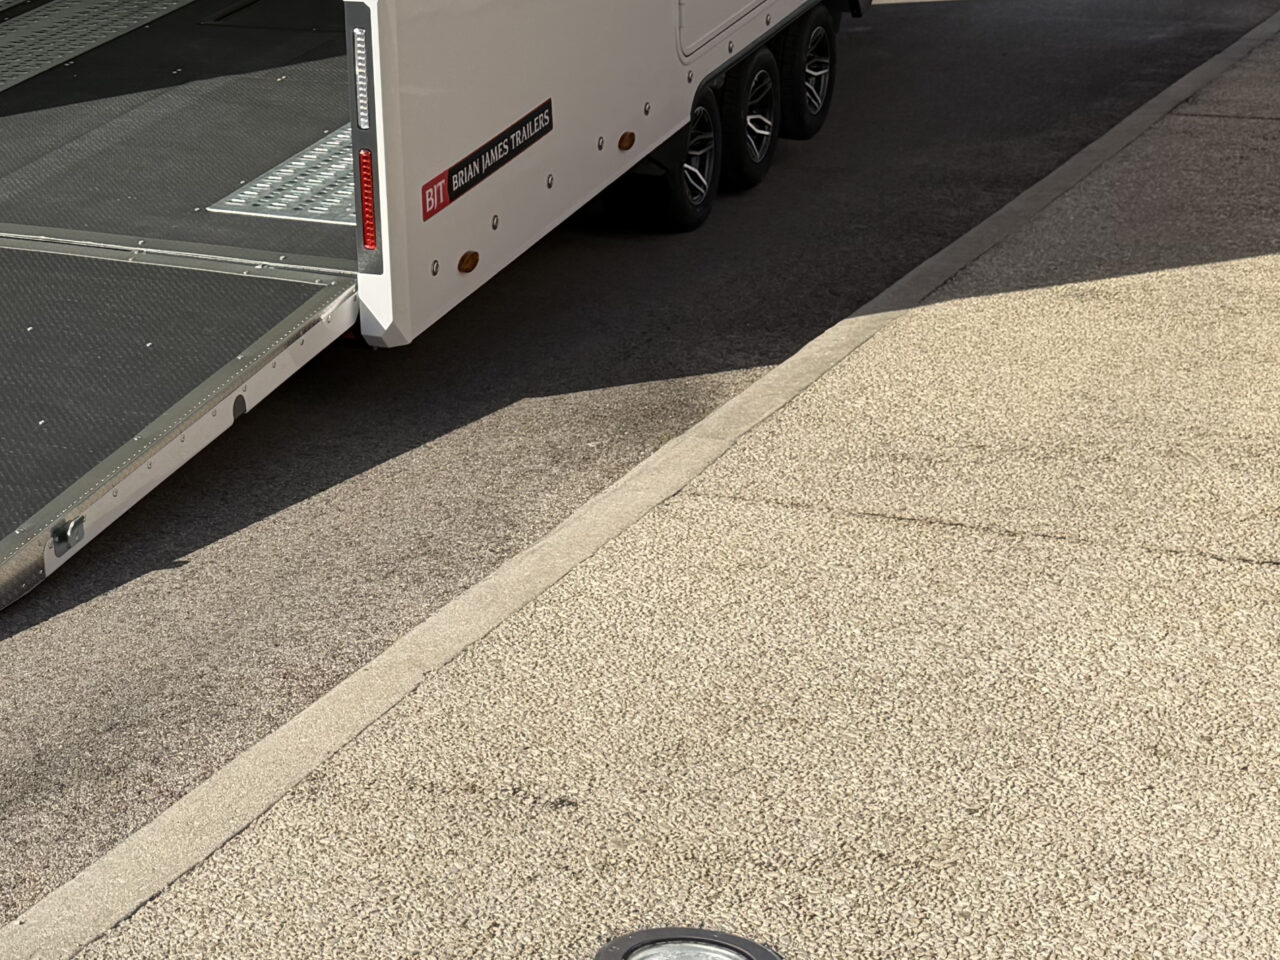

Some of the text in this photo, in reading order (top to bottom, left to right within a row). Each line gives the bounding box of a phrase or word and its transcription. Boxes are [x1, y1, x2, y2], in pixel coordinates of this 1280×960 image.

[425, 109, 550, 213] BJT BRIAN JAMES TRAILERS
